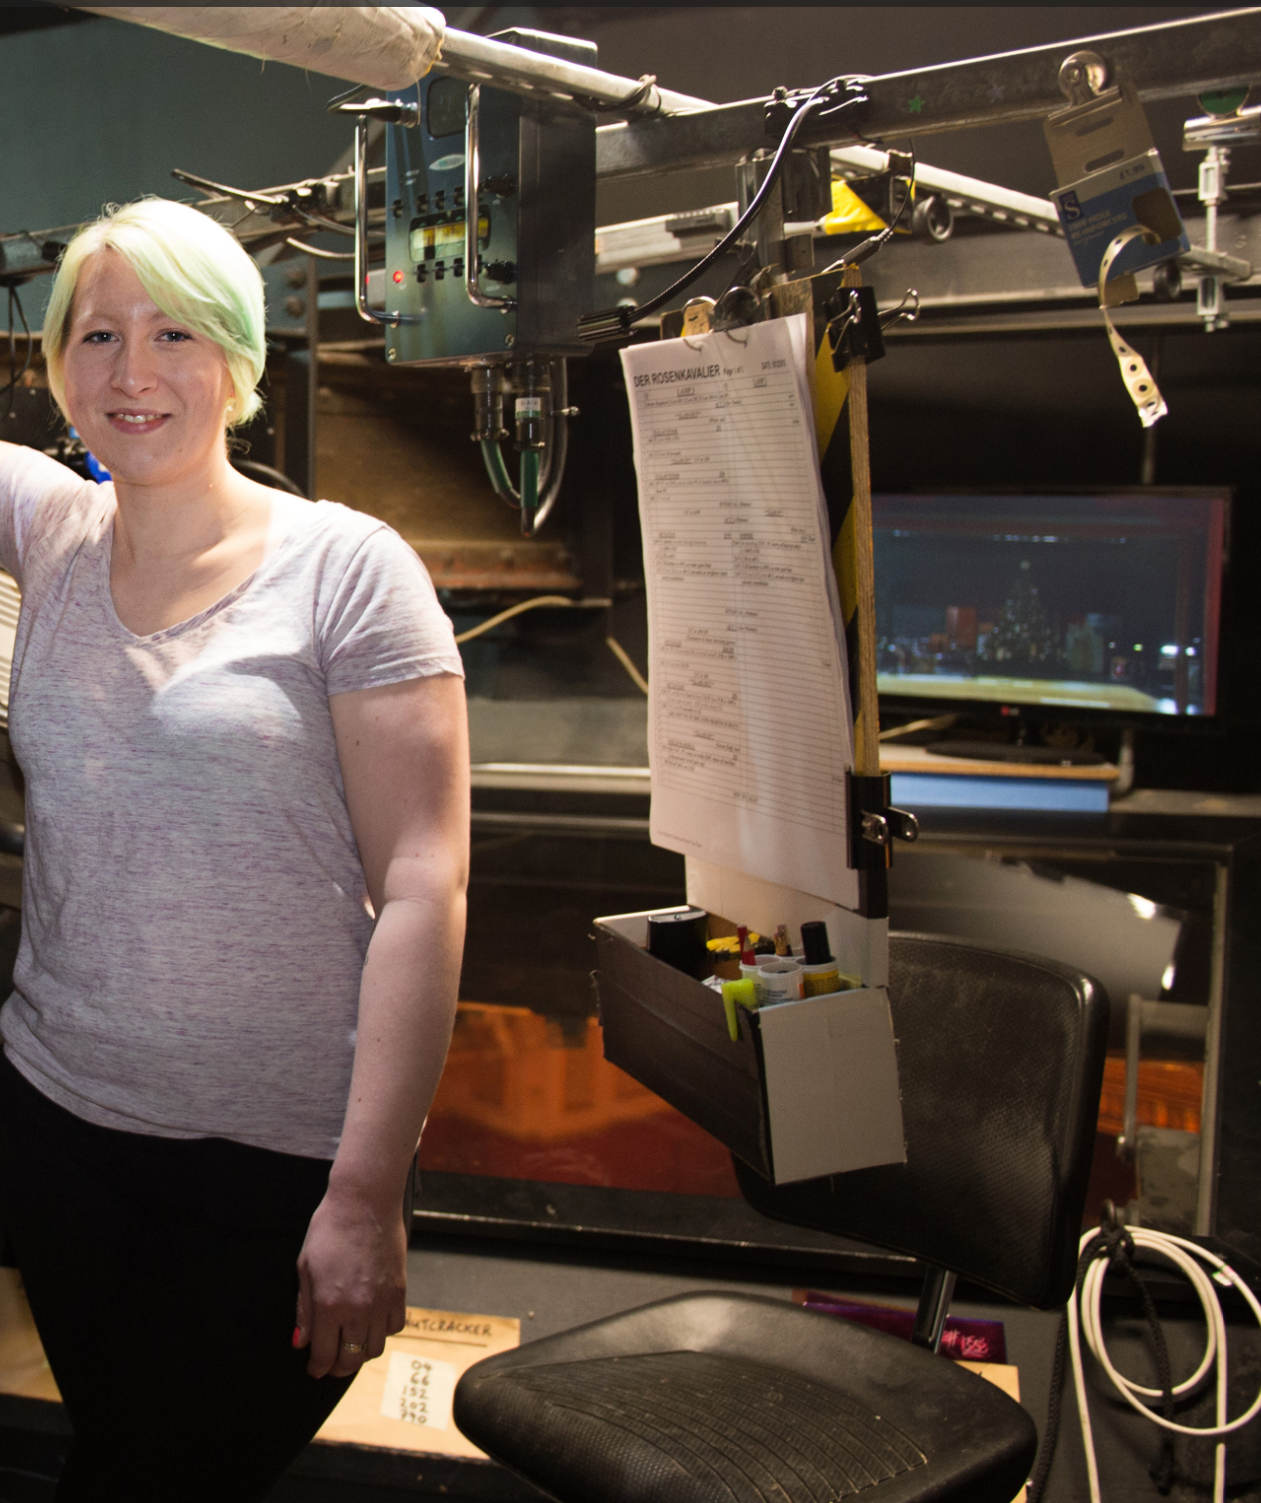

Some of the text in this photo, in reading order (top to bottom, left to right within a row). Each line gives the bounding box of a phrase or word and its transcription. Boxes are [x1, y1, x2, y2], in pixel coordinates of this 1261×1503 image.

[634, 375, 650, 387] DER
[653, 365, 720, 384] ROSENKAVALIER
[411, 1360, 433, 1373] 04
[411, 1372, 429, 1386] 66
[402, 1385, 428, 1400] 152
